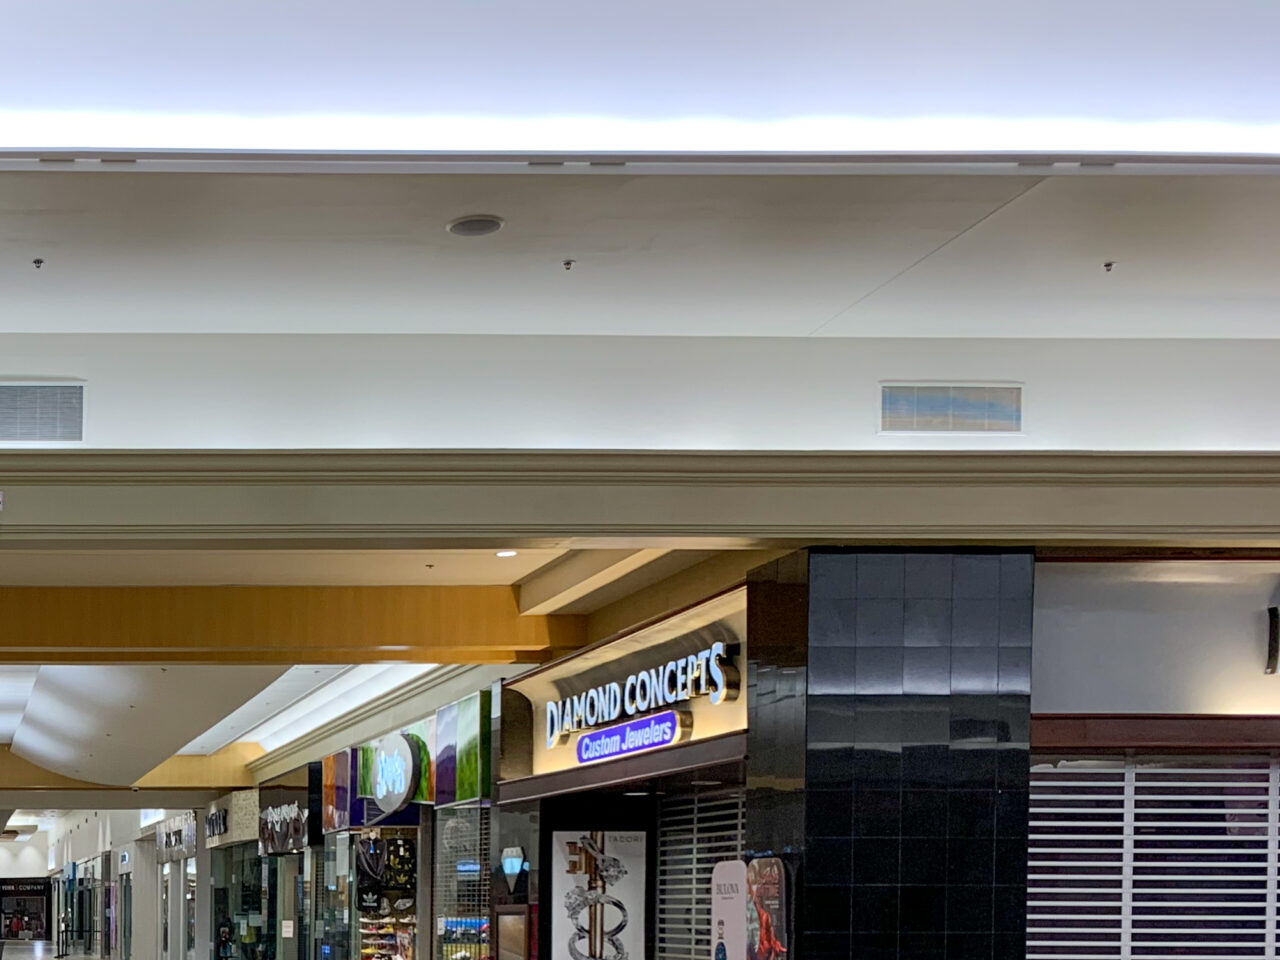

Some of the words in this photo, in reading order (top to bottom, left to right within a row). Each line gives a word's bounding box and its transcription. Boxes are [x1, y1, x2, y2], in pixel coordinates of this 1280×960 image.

[546, 682, 621, 750] DIAMOND
[623, 641, 727, 706] CONCEPTS
[581, 731, 621, 761] Custom
[621, 719, 673, 752] Jewelers
[608, 835, 643, 843] TACORI
